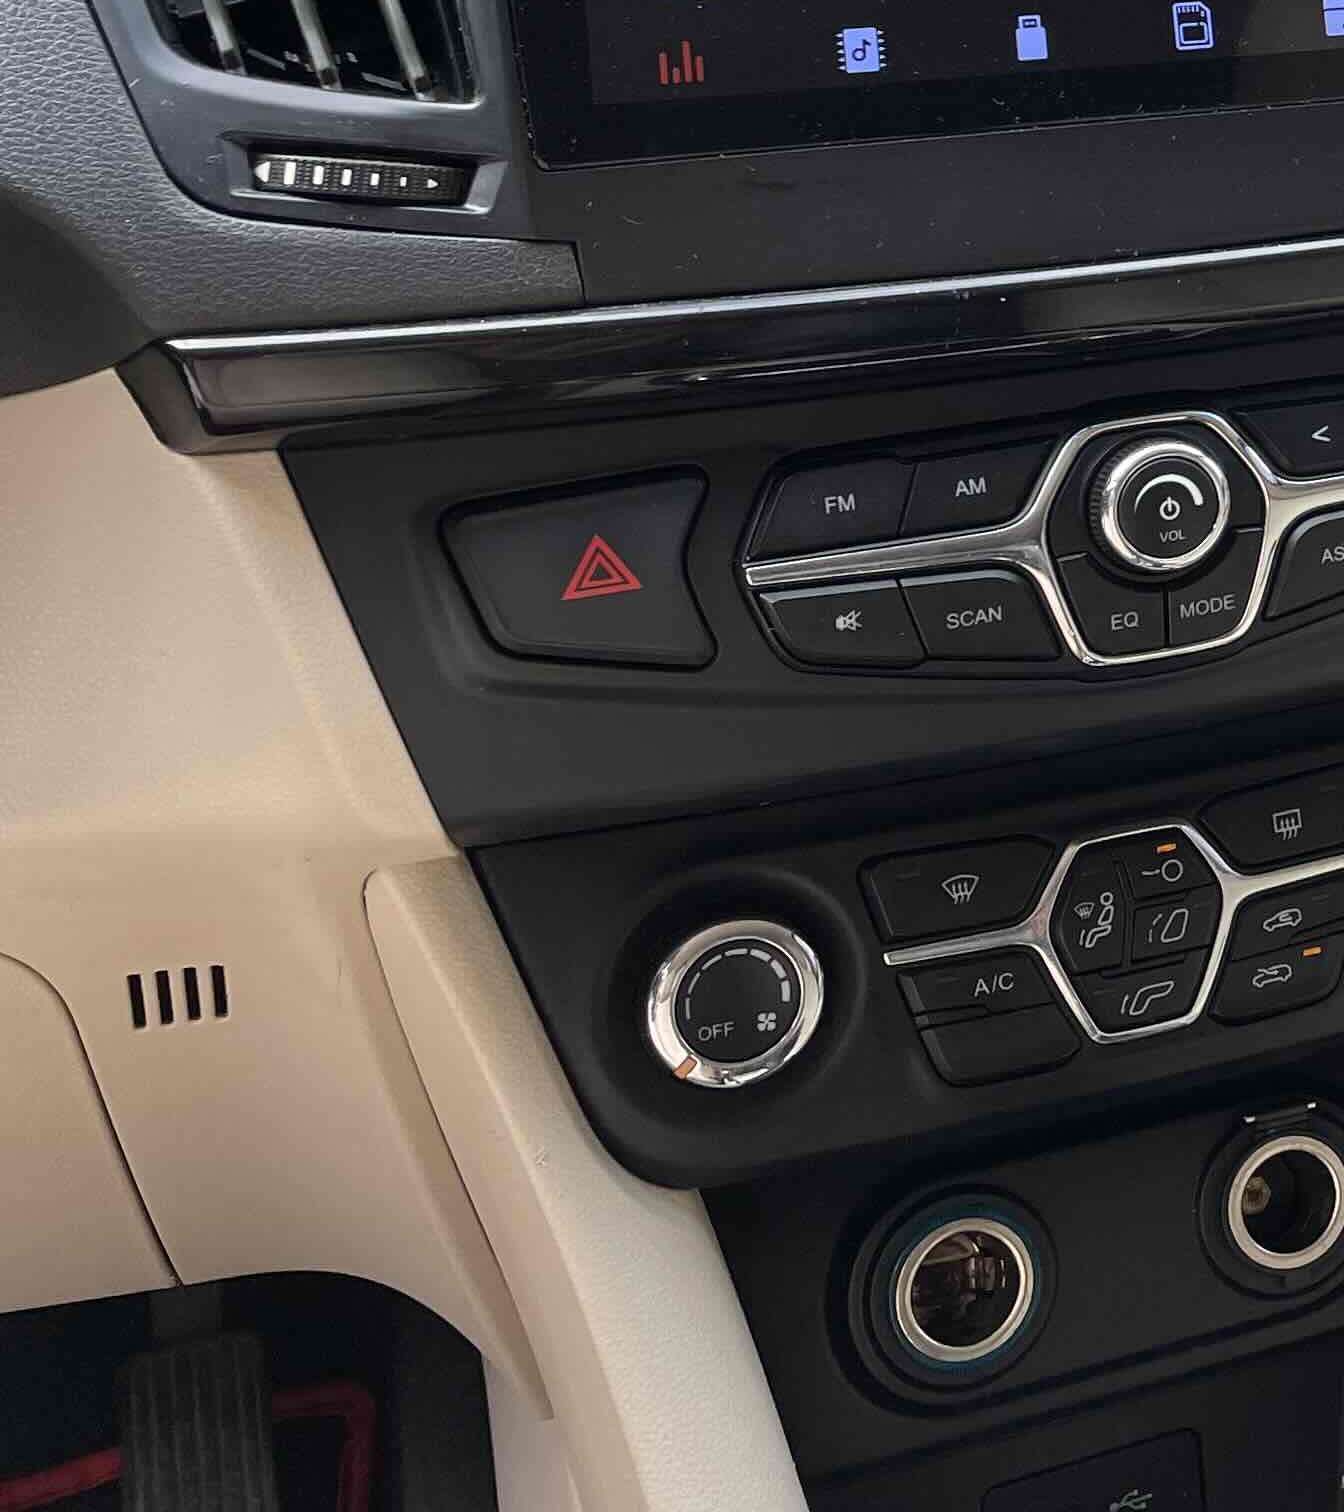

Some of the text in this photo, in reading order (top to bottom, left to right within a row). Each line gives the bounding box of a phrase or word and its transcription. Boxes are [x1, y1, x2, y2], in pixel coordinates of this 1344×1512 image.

[954, 476, 988, 496] AM
[824, 493, 856, 514] FM
[1159, 529, 1187, 543] VOL
[1179, 593, 1237, 619] MODE
[946, 605, 1004, 630] SCAN
[1110, 611, 1140, 631] EQ
[973, 972, 1015, 997] A/C
[698, 1021, 735, 1042] OFF
